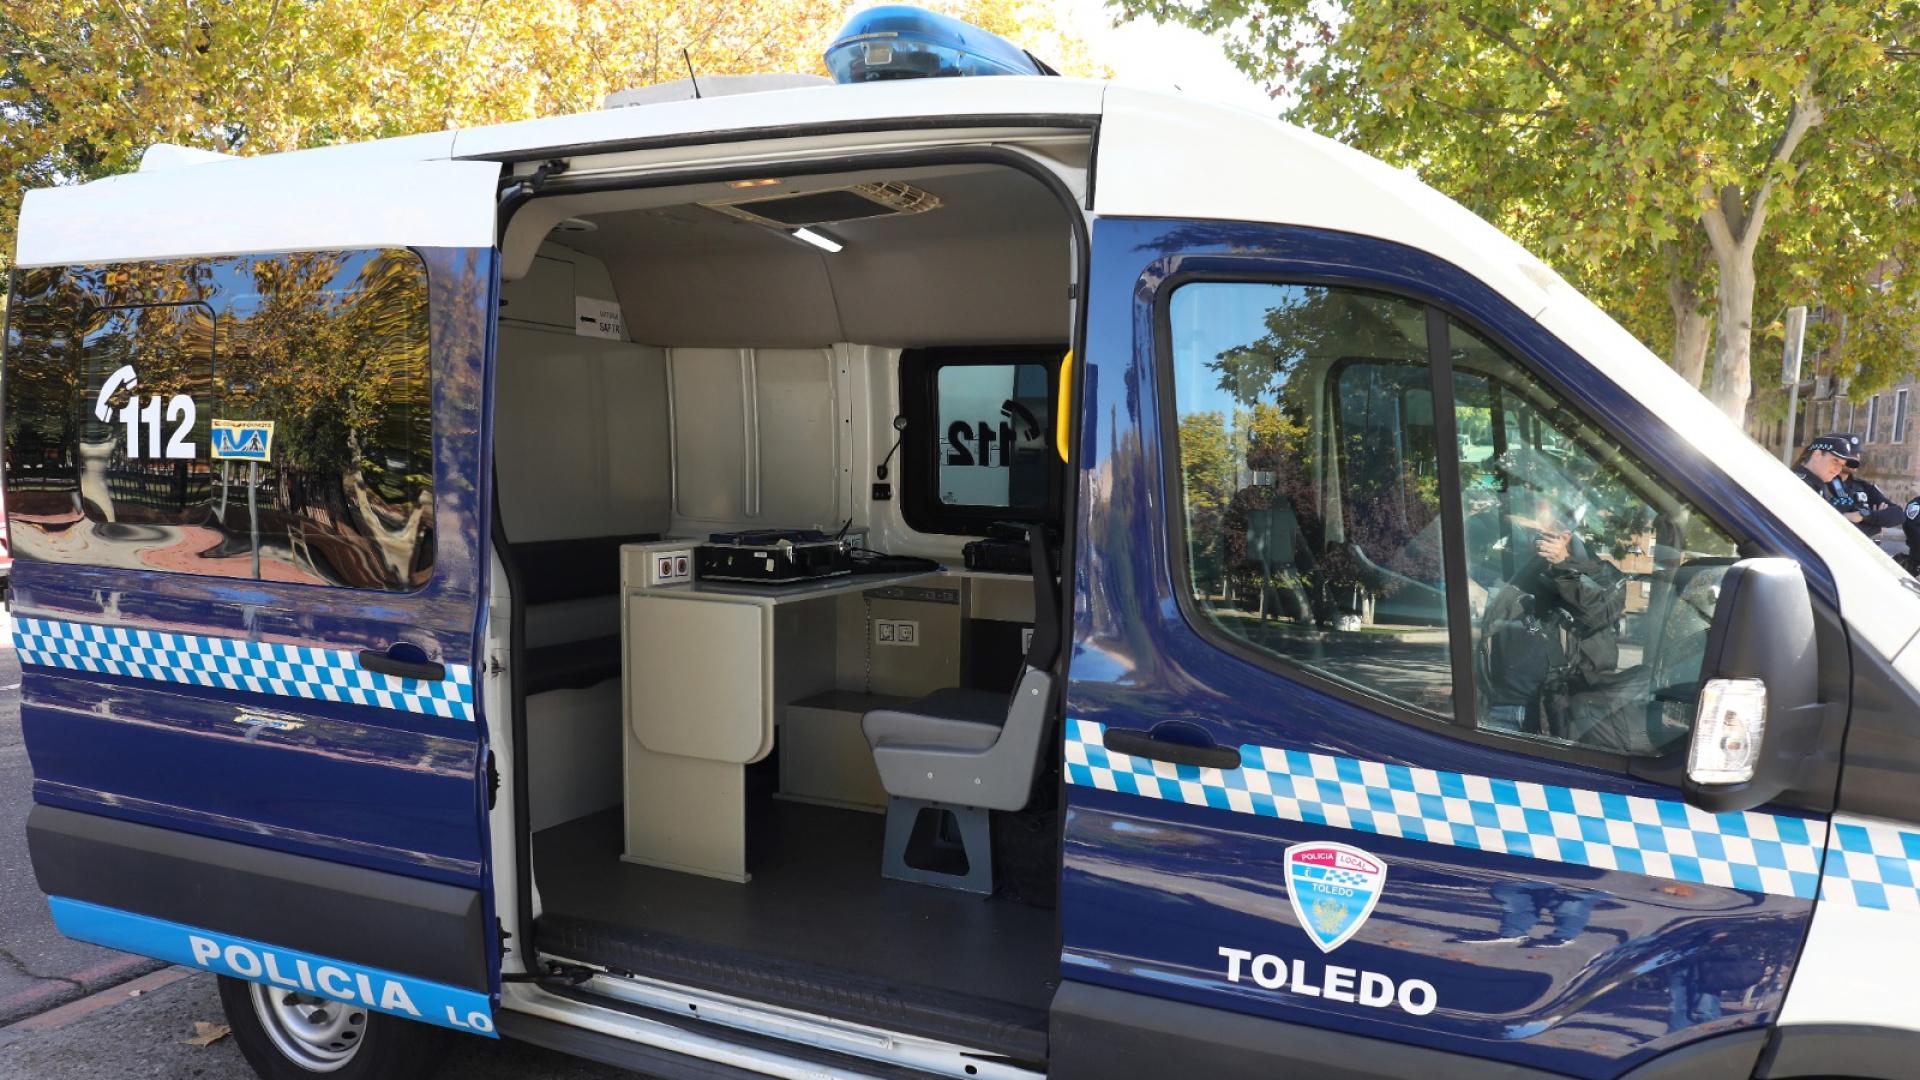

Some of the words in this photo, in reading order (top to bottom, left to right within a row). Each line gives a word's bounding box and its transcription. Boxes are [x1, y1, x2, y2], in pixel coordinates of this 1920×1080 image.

[119, 394, 197, 458] 112
[1301, 852, 1334, 861] POLICIA
[1339, 855, 1367, 871] LOCAL
[1312, 883, 1354, 897] TOLEDO
[189, 935, 422, 1016] POLICIA
[446, 1006, 494, 1032] LO
[1218, 946, 1438, 1016] TOLEDO
